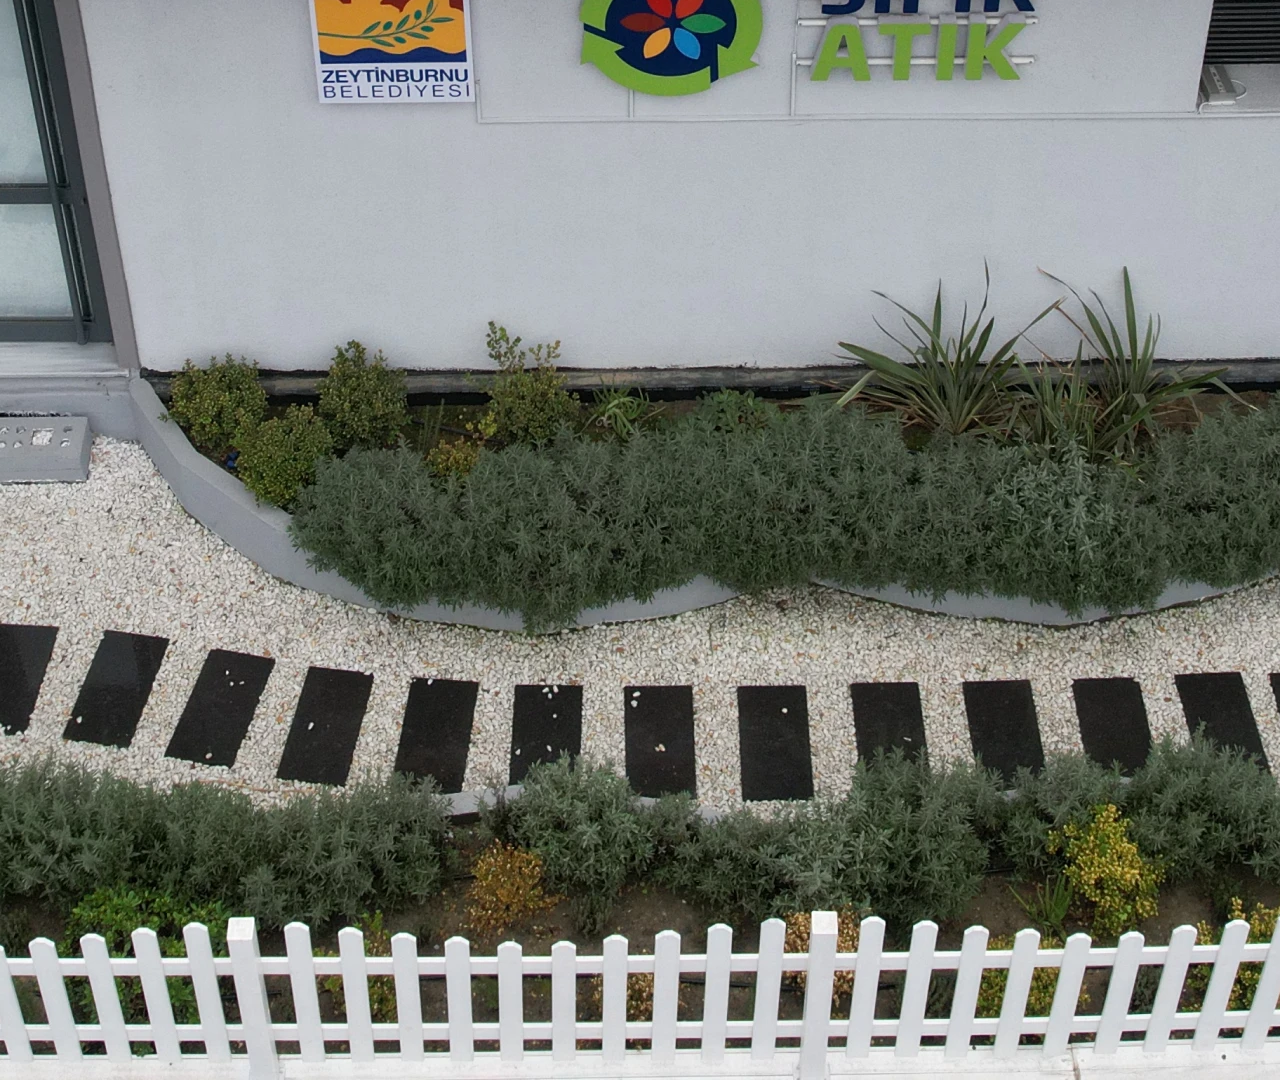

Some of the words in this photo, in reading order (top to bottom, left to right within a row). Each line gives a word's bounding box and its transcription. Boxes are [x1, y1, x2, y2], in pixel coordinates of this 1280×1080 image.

[809, 22, 1028, 82] ATIK
[321, 66, 469, 84] ZEYTİNBURNU
[323, 82, 470, 99] BELEDİYESİ
